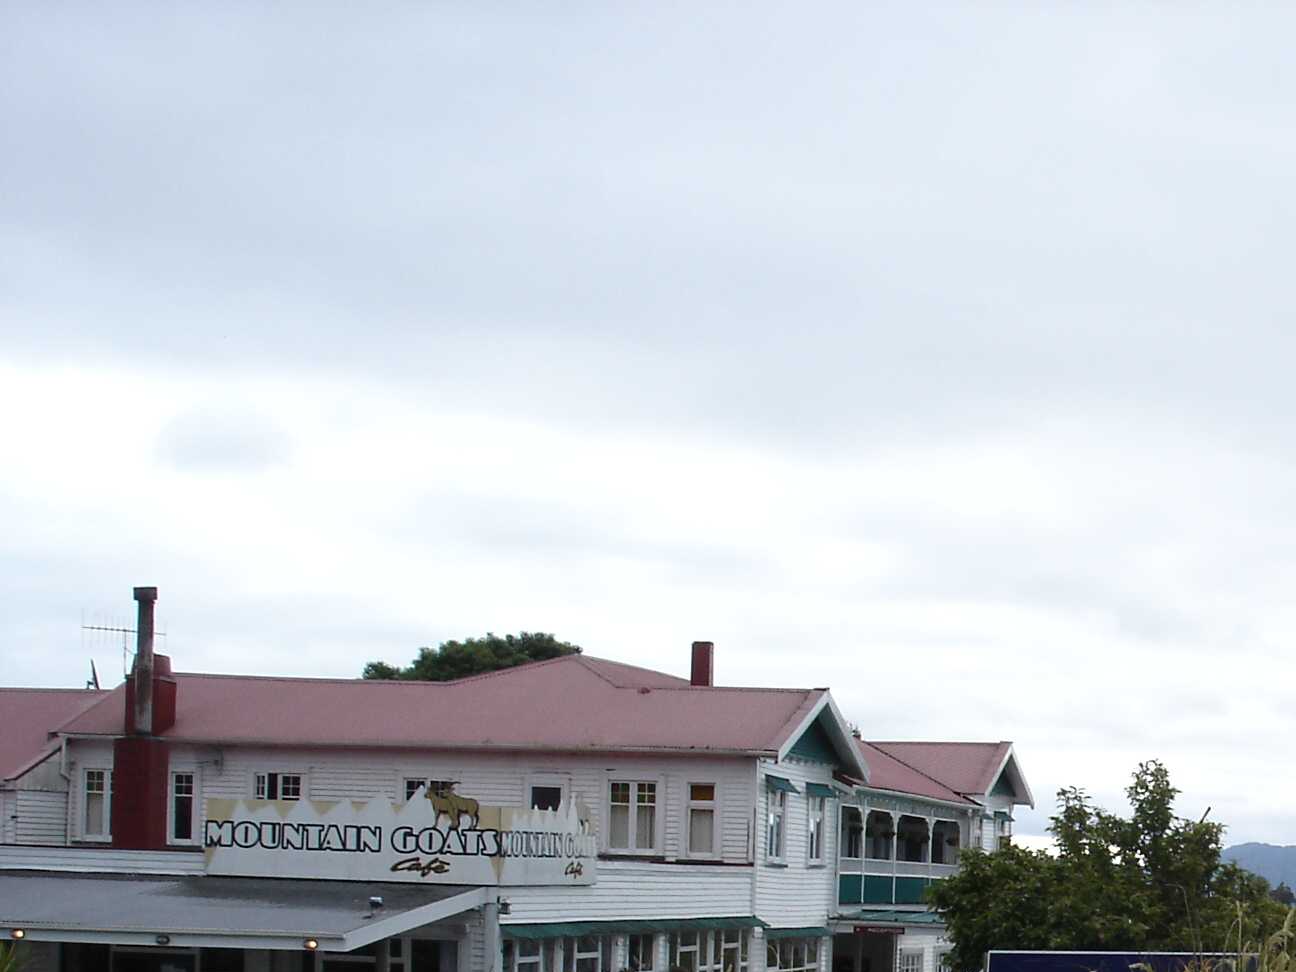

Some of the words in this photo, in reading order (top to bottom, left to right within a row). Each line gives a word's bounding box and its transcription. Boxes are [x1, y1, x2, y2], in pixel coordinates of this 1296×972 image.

[205, 820, 382, 853] MOUNTAIN
[390, 826, 500, 857] GOATS
[500, 831, 563, 857] MOUNTAIN
